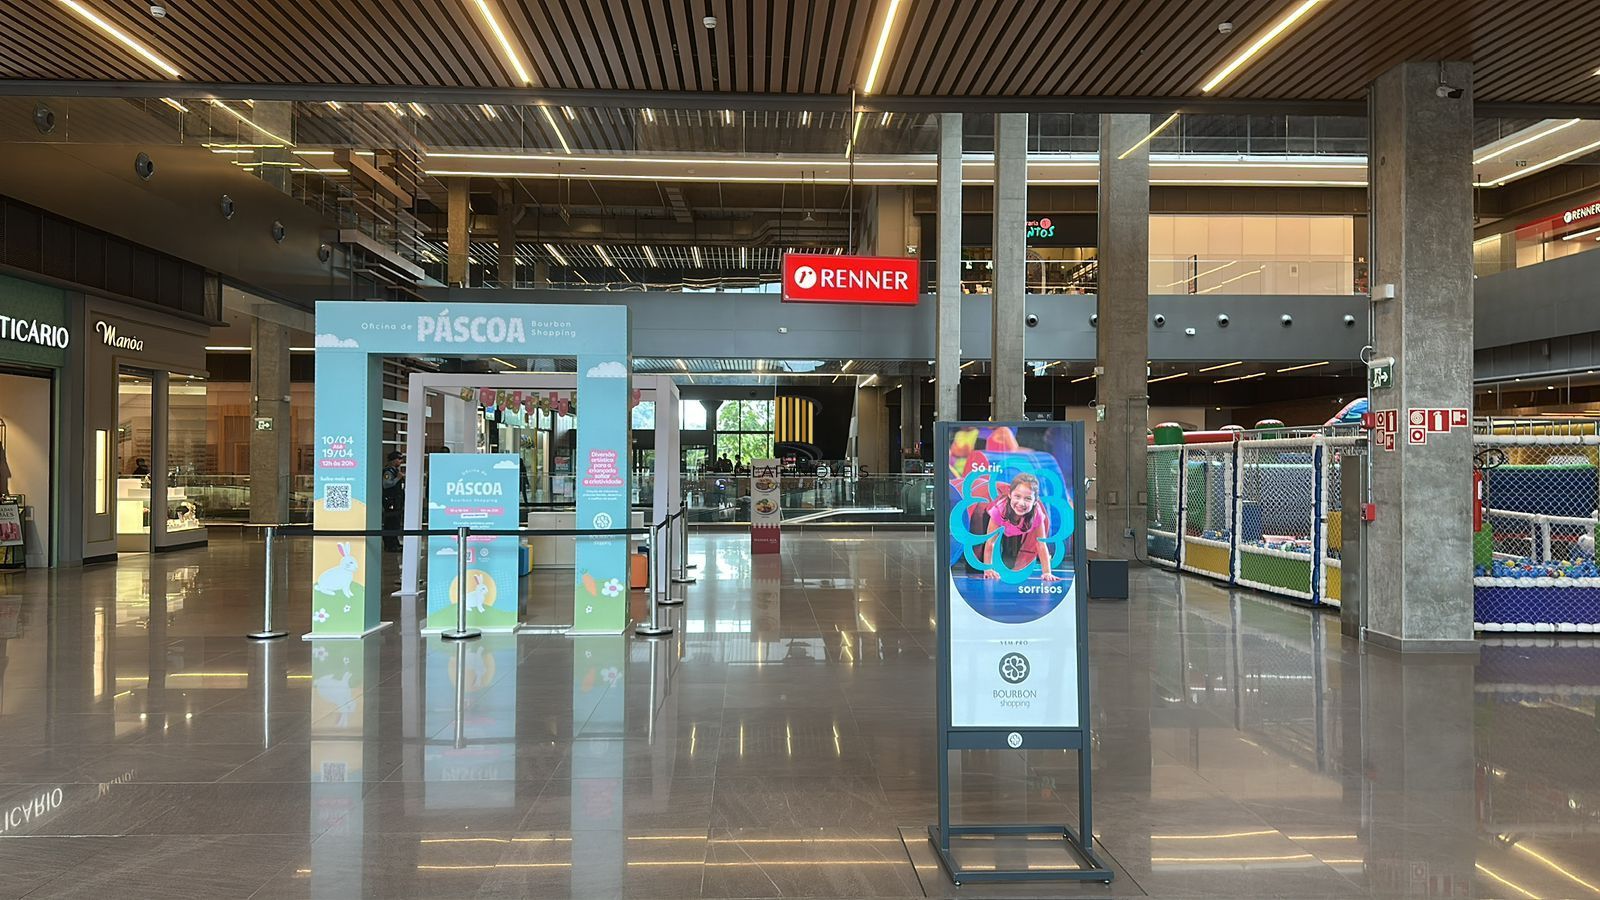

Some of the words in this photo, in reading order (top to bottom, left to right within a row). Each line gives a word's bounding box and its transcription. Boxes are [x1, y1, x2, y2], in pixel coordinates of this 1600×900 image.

[1572, 203, 1600, 221] RENNER
[821, 268, 909, 290] RENNER
[361, 321, 397, 331] Oficina
[400, 322, 412, 331] de
[417, 308, 526, 343] PÁSCOA
[531, 329, 576, 337] Shopping
[321, 436, 354, 445] 10/04
[322, 449, 353, 458] 19/04
[971, 463, 986, 473] Só
[988, 463, 1003, 474] rir,
[446, 478, 503, 496] PÁSCOA
[1018, 583, 1063, 594] sorrisos
[993, 689, 1037, 698] BOURBON
[1000, 699, 1030, 709] shopping
